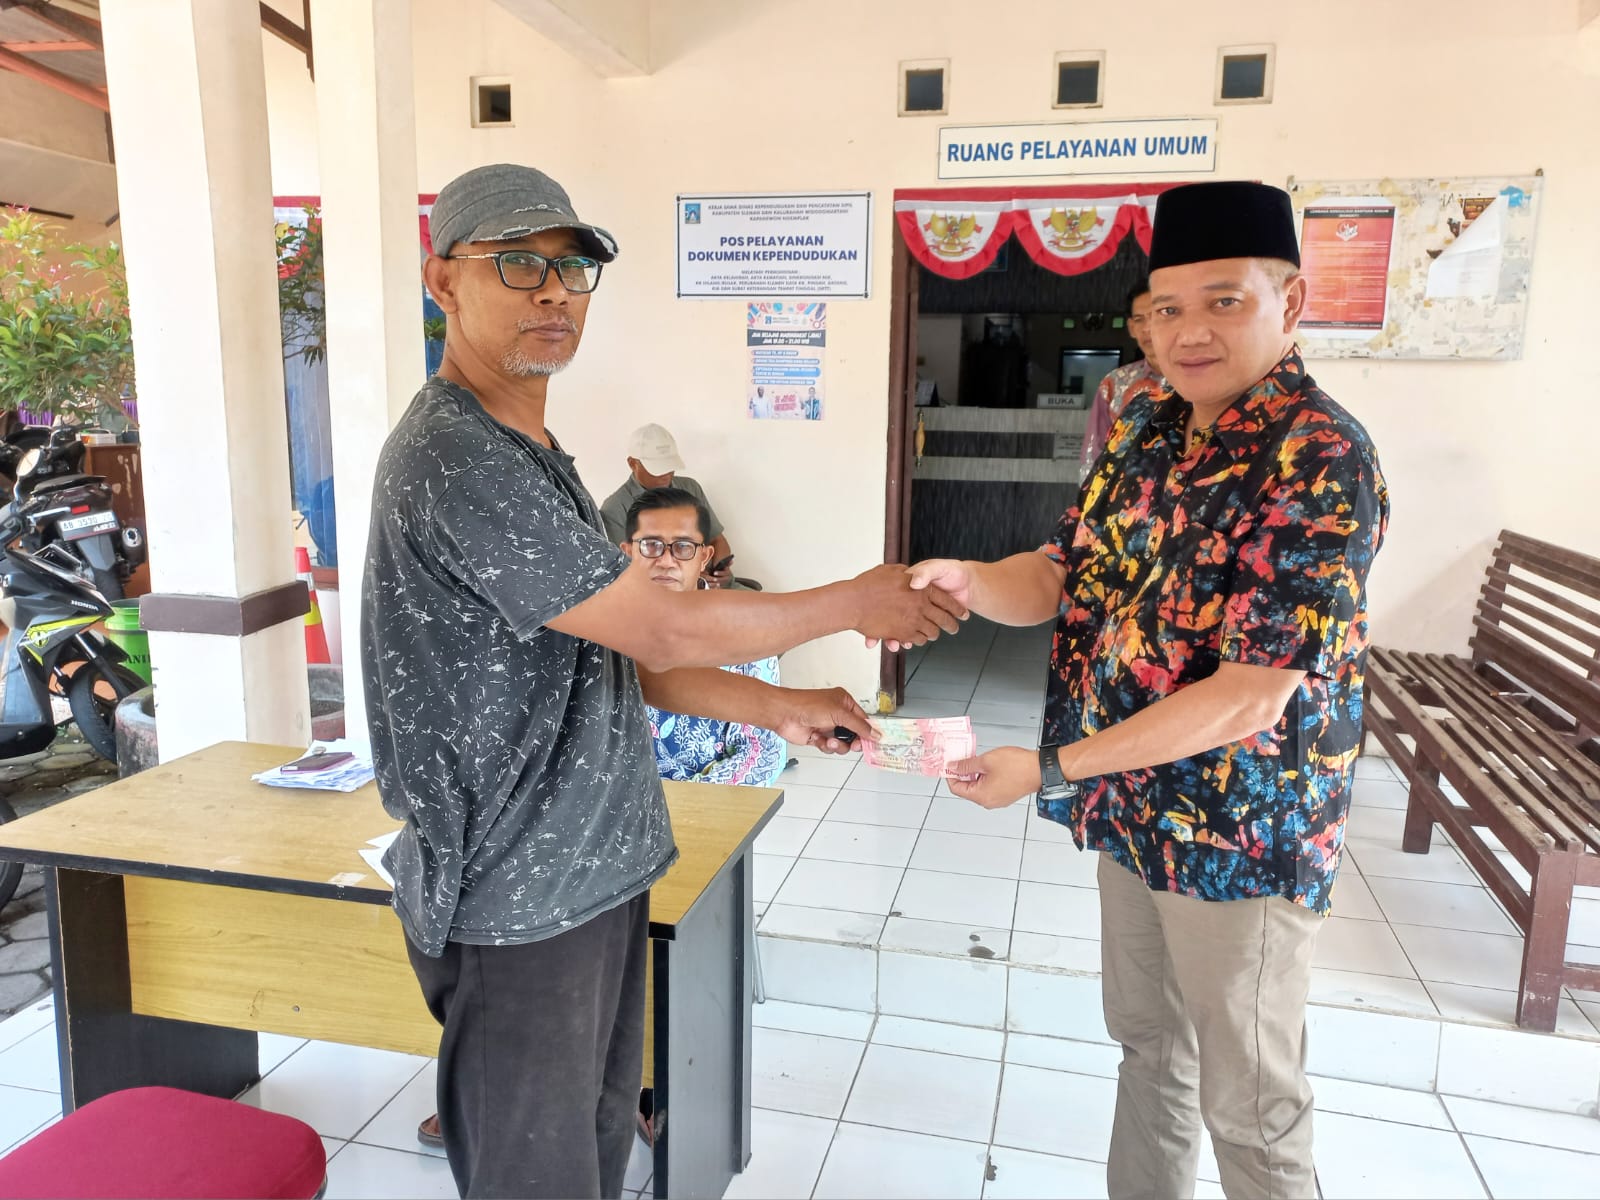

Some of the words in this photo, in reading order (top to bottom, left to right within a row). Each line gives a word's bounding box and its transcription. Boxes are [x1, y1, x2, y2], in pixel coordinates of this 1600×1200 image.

[948, 142, 1014, 162] RUANG
[1020, 138, 1137, 160] PELAYANAN
[1144, 135, 1208, 156] UMUM
[720, 236, 745, 247] POS
[747, 236, 824, 246] PELAYANAN
[688, 251, 751, 261] DOKUMEN
[753, 250, 857, 261] KEPENDUDUKAN
[1047, 397, 1074, 405] BUKA
[70, 600, 99, 611] HONDA
